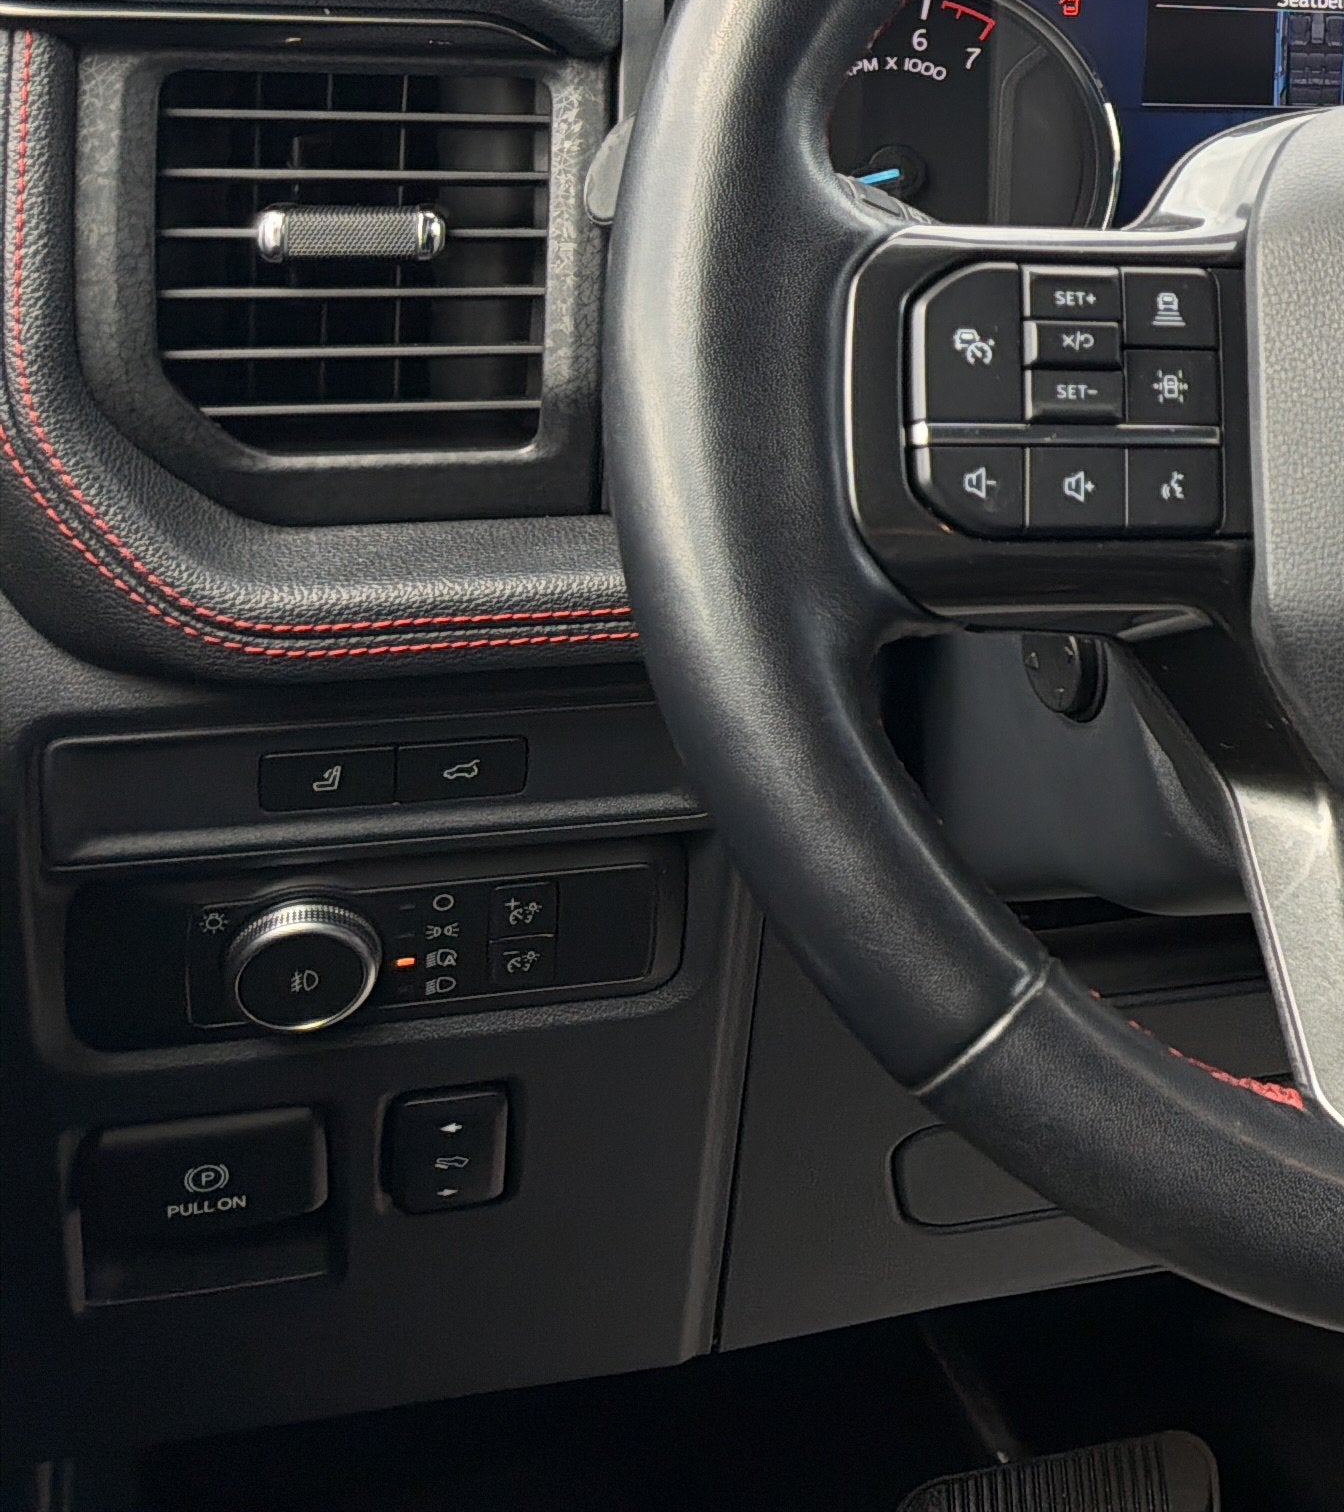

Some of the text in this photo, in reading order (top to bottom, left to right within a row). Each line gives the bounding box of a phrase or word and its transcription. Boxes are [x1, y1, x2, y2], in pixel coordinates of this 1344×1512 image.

[912, 29, 928, 51] 6
[884, 56, 898, 70] X
[904, 58, 947, 81] 1000
[965, 47, 981, 70] 7
[1054, 291, 1096, 306] SET+
[1056, 384, 1098, 400] SET-
[201, 1171, 215, 1186] P
[167, 1195, 247, 1218] PULL ON
